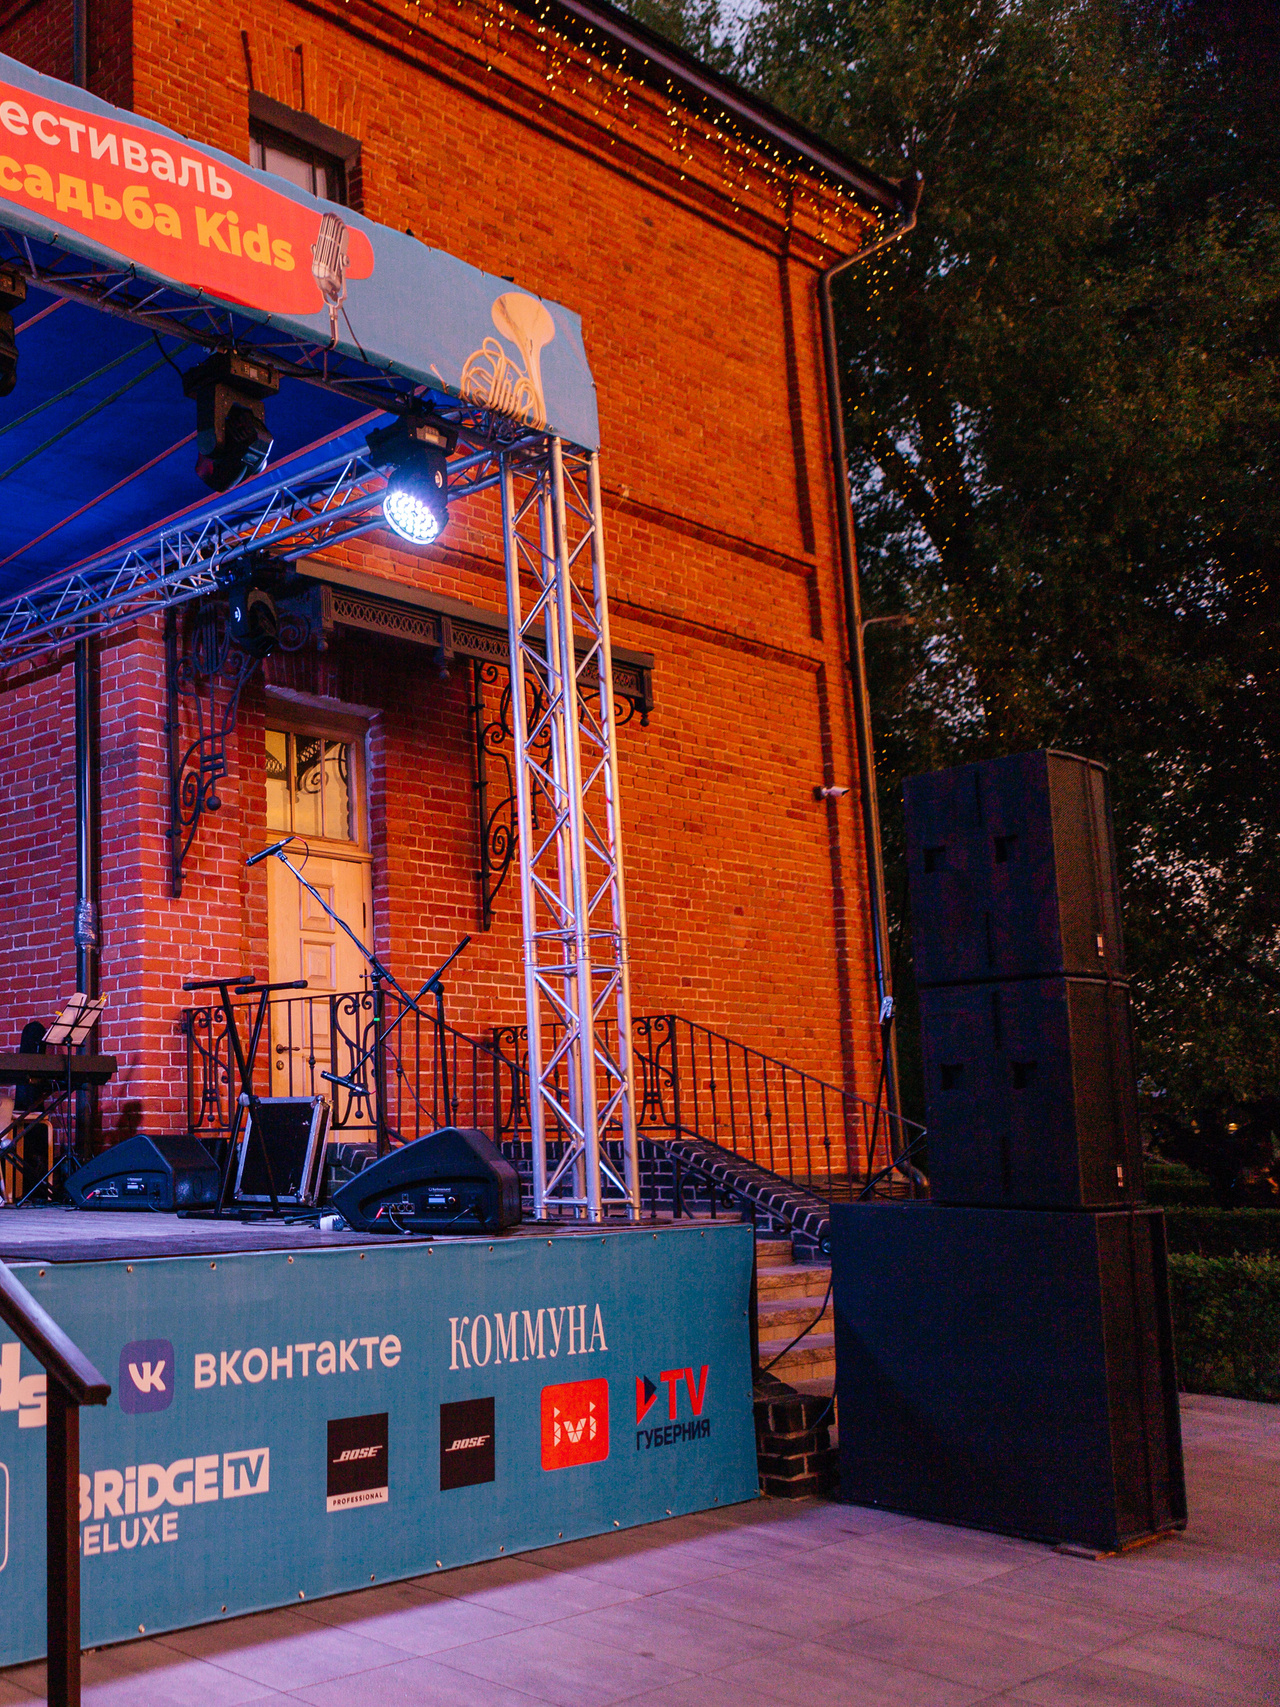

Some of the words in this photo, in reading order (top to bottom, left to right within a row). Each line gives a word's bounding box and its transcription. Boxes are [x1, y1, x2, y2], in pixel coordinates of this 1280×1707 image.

[195, 205, 296, 271] Kids
[448, 1303, 608, 1370] КОММУНА
[128, 1360, 166, 1393] VK
[660, 1364, 709, 1420] TV
[445, 1435, 490, 1451] BOSE
[636, 1418, 710, 1450] ГУБЕРНИЯ
[226, 1452, 266, 1492] TV
[332, 1445, 383, 1463] BOSE
[332, 1492, 383, 1506] PROFESSIONAL
[80, 1512, 178, 1556] ELUXE
